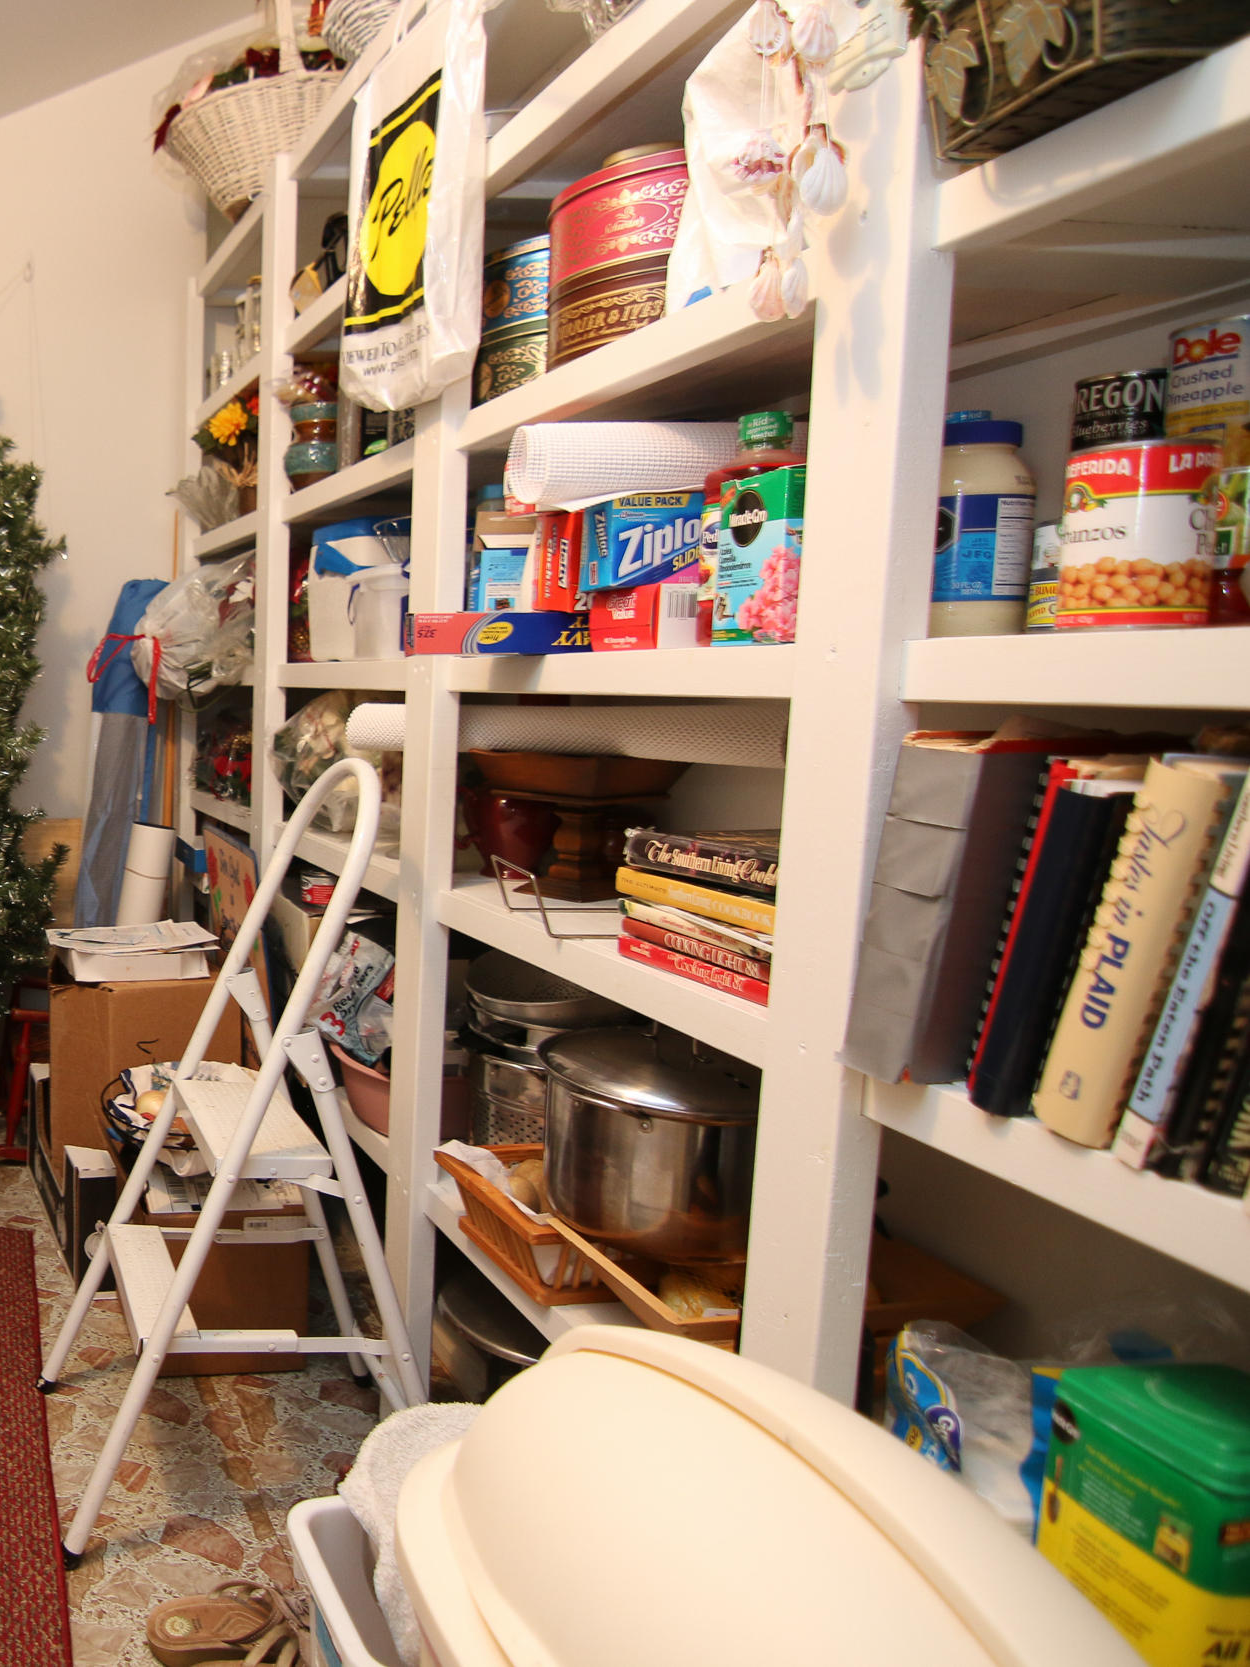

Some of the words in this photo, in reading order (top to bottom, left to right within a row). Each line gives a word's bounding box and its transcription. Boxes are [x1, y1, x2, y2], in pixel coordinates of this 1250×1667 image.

[371, 146, 433, 262] Pella
[620, 300, 662, 323] IVES
[1173, 328, 1241, 364] Dole
[1171, 364, 1233, 389] Crushed
[1075, 378, 1166, 415] REGON
[1074, 419, 1147, 436] lueberries
[1168, 453, 1193, 473] LA
[618, 496, 652, 507] VALUE
[654, 495, 683, 505] PACK
[593, 511, 608, 559] Ziploc
[617, 517, 703, 578] Ziplo
[606, 592, 638, 611] Great
[612, 608, 636, 620] Value
[645, 840, 672, 864] The
[672, 848, 712, 873] Southern
[711, 900, 773, 928] COOKBOOK
[1112, 898, 1144, 928] in
[664, 932, 710, 960] COOKING
[711, 946, 743, 974] LIGHT
[1182, 944, 1202, 980] the
[673, 957, 711, 986] Cooking
[710, 966, 732, 989] Light
[1080, 932, 1131, 1031] PLAID
[319, 1010, 346, 1037] 3
[1156, 984, 1187, 1048] Eaten
[1136, 1054, 1163, 1103] Path
